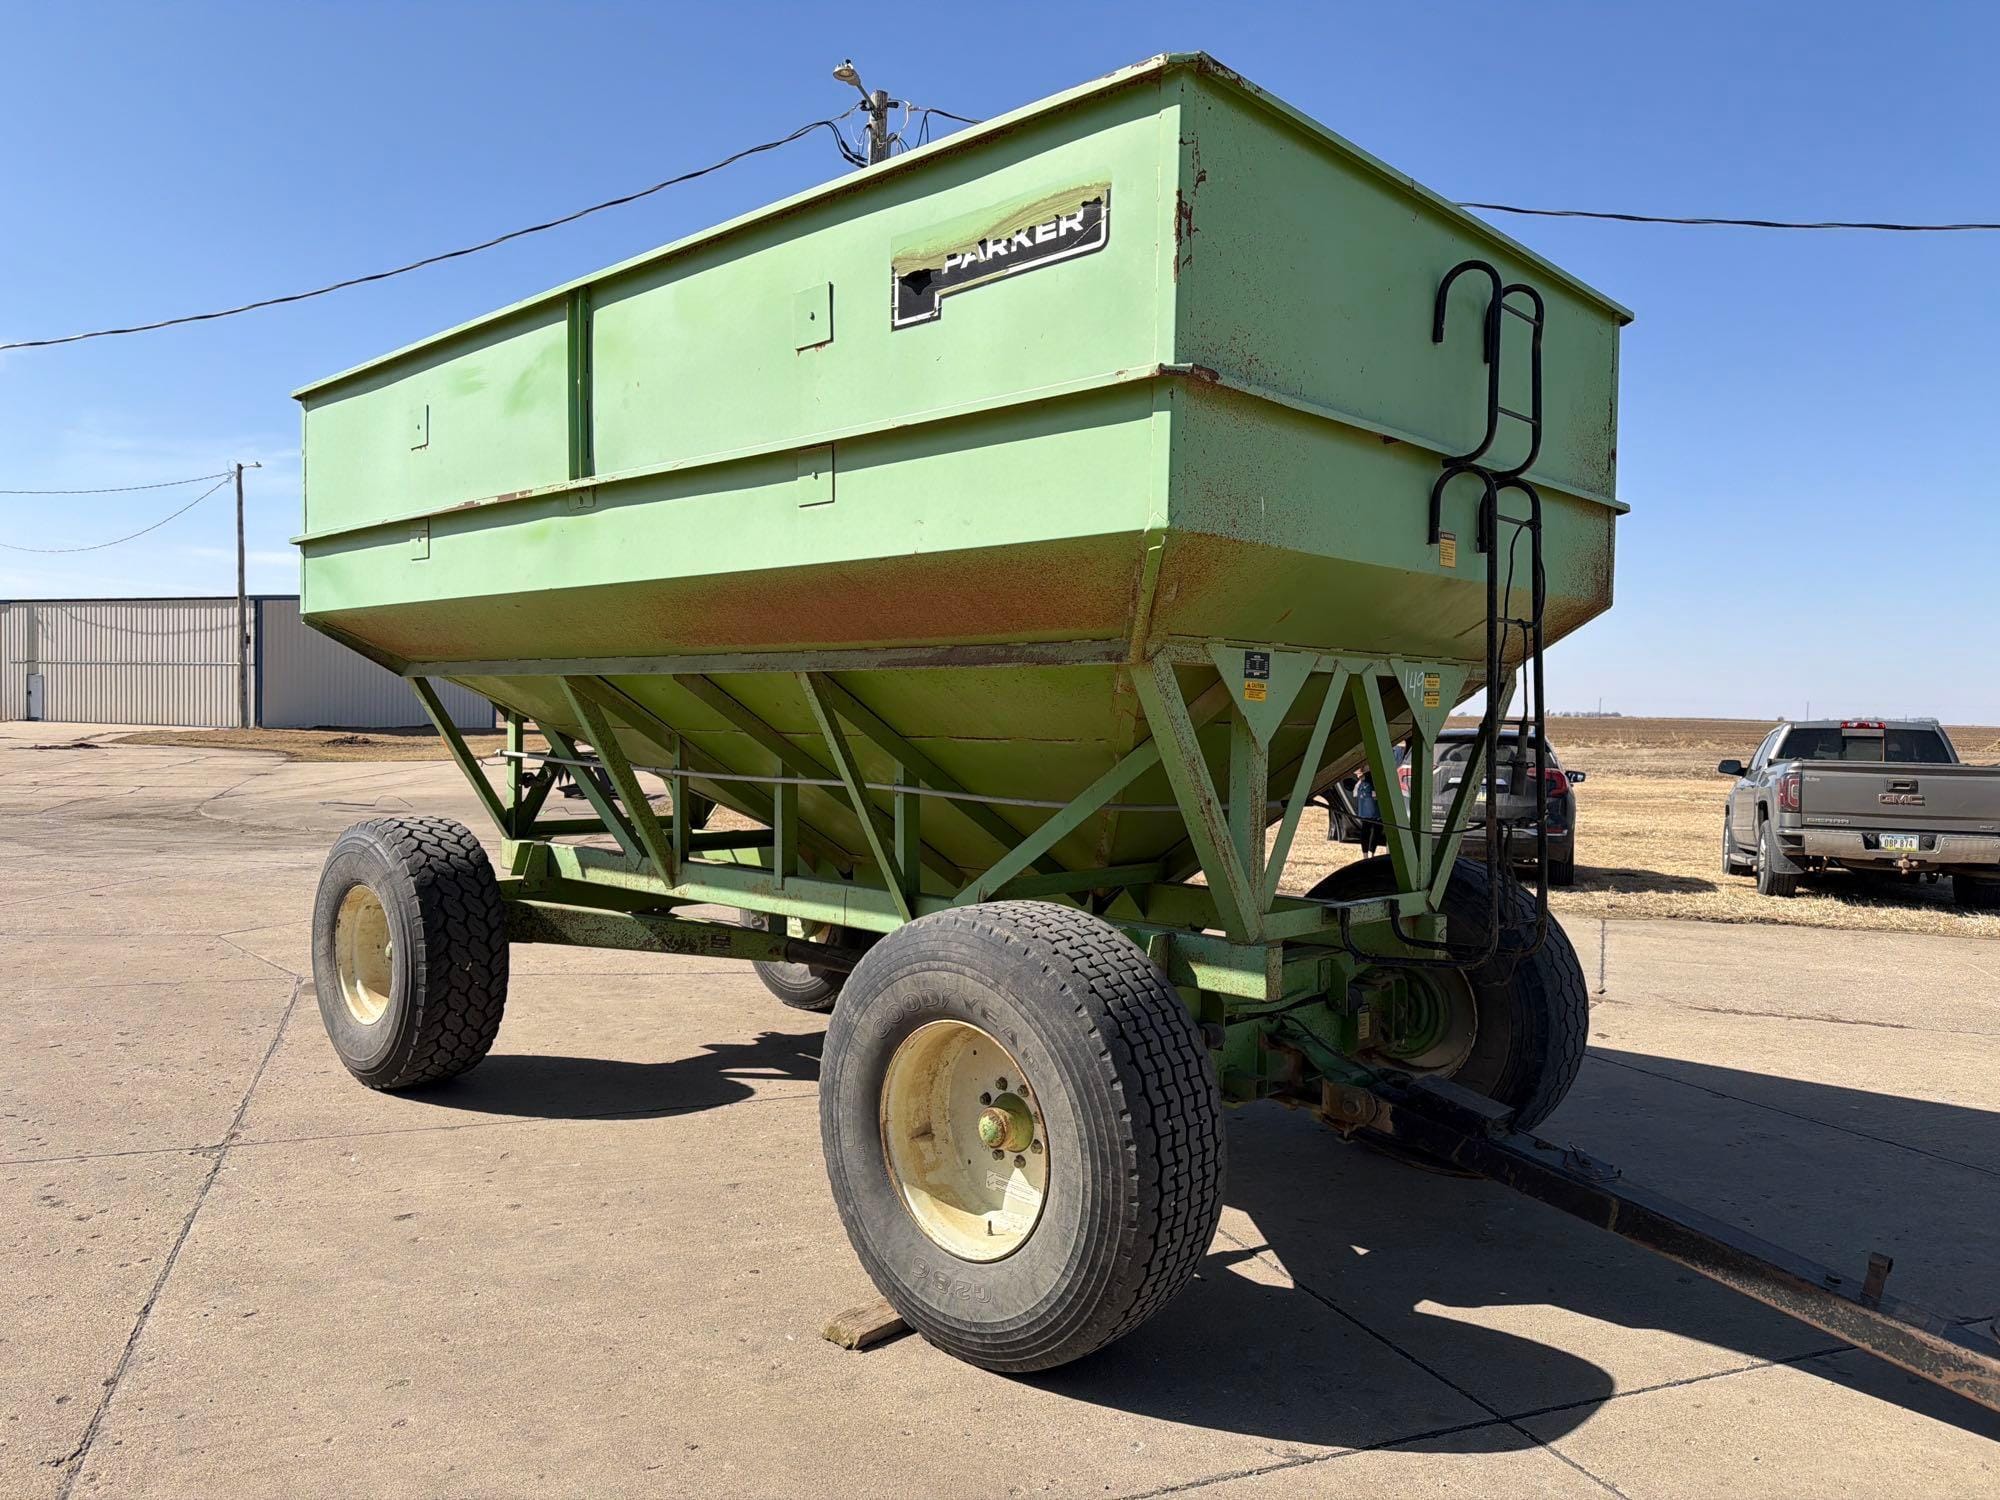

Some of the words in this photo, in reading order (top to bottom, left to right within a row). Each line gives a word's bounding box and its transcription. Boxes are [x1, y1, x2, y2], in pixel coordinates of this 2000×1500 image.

[942, 208, 1084, 274] PARKER
[1405, 668, 1425, 702] 149
[1879, 794, 1923, 805] GMC
[872, 987, 1039, 1075] GOODYEAR
